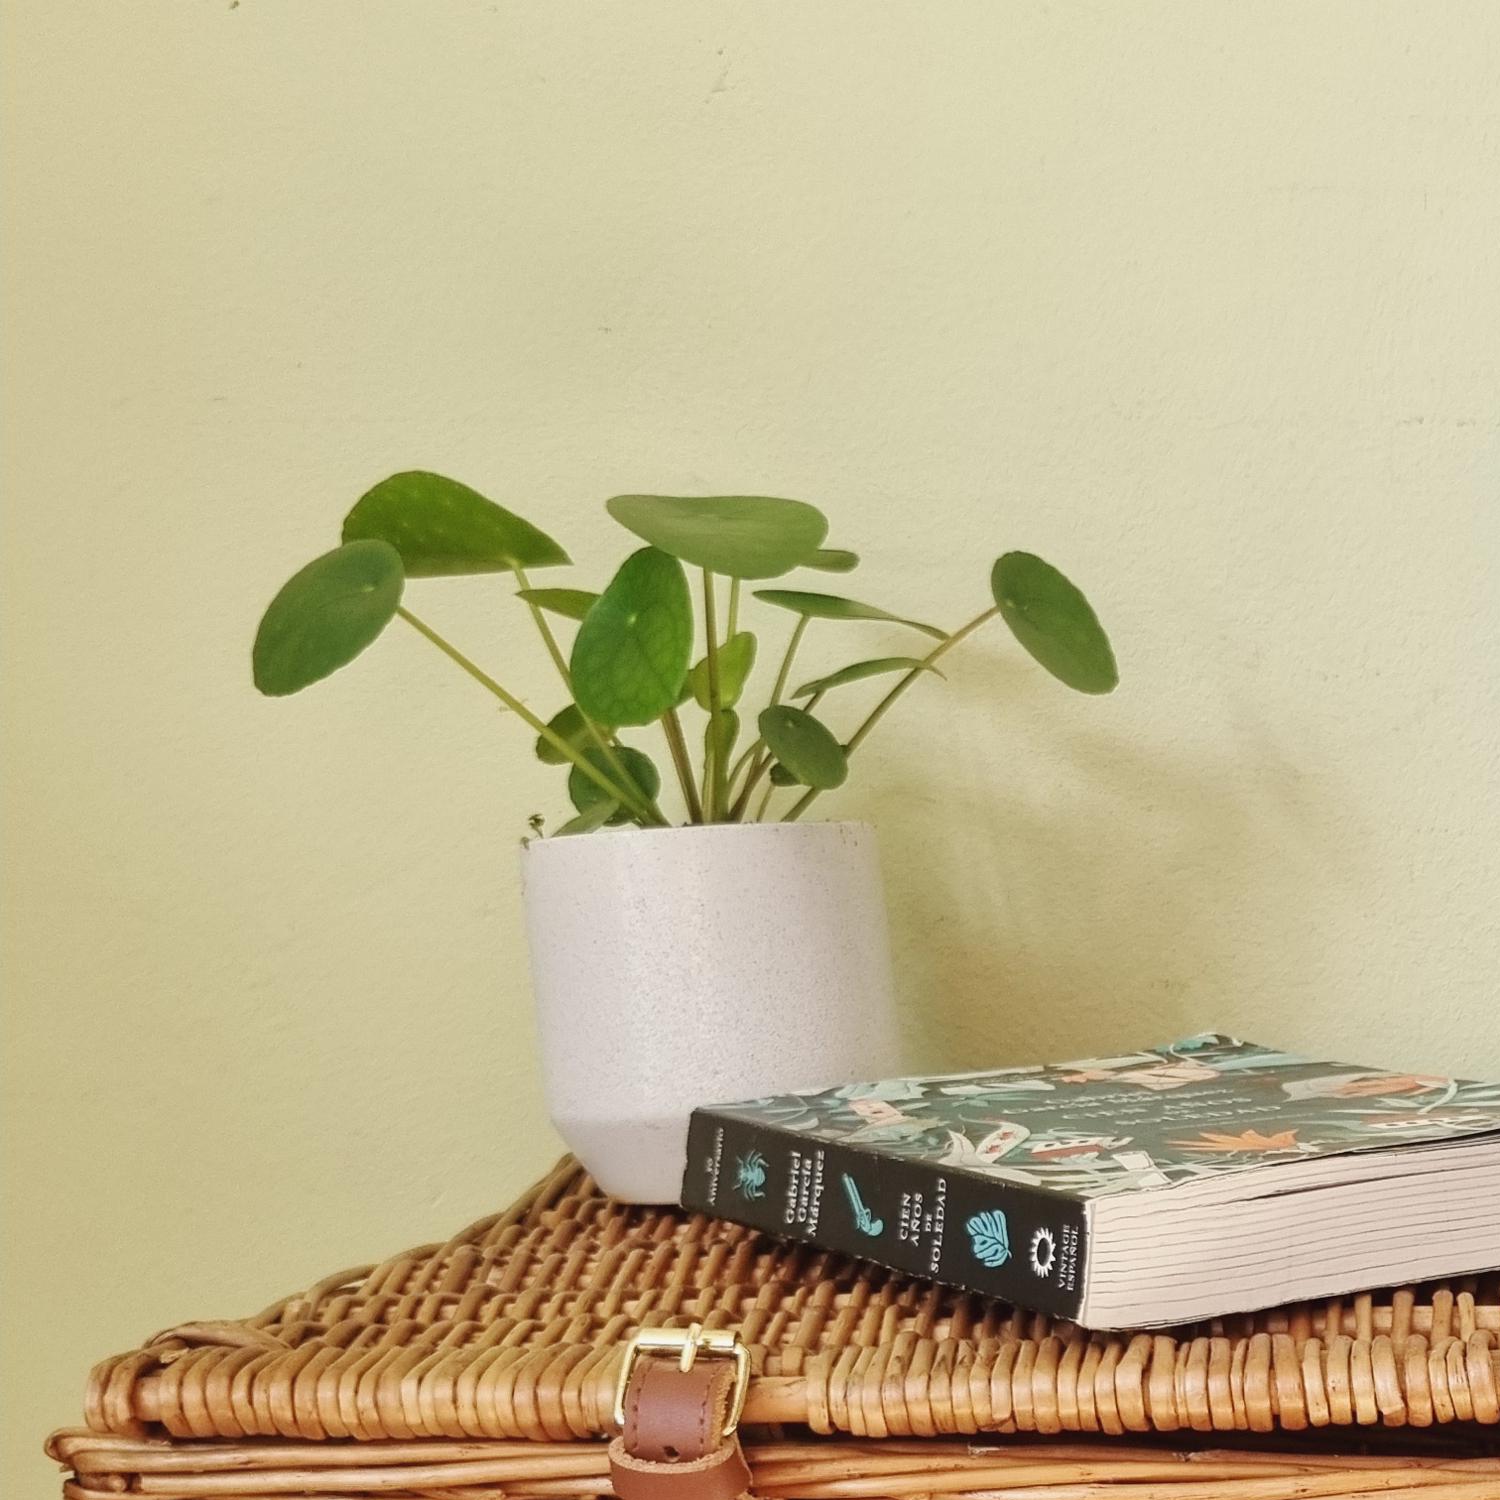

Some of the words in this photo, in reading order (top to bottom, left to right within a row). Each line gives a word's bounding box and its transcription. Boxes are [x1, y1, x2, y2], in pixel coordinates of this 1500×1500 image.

[784, 1150, 802, 1224] Gabriel
[797, 1159, 813, 1223] García
[806, 1150, 825, 1238] Márquez
[900, 1193, 912, 1241] CIEN
[910, 1193, 924, 1247] AÑOS
[924, 1213, 933, 1233] DE
[930, 1178, 948, 1274] SOLEDAD
[1057, 1223, 1071, 1289] VINTAGE
[1066, 1225, 1080, 1292] ESPAÑOL
